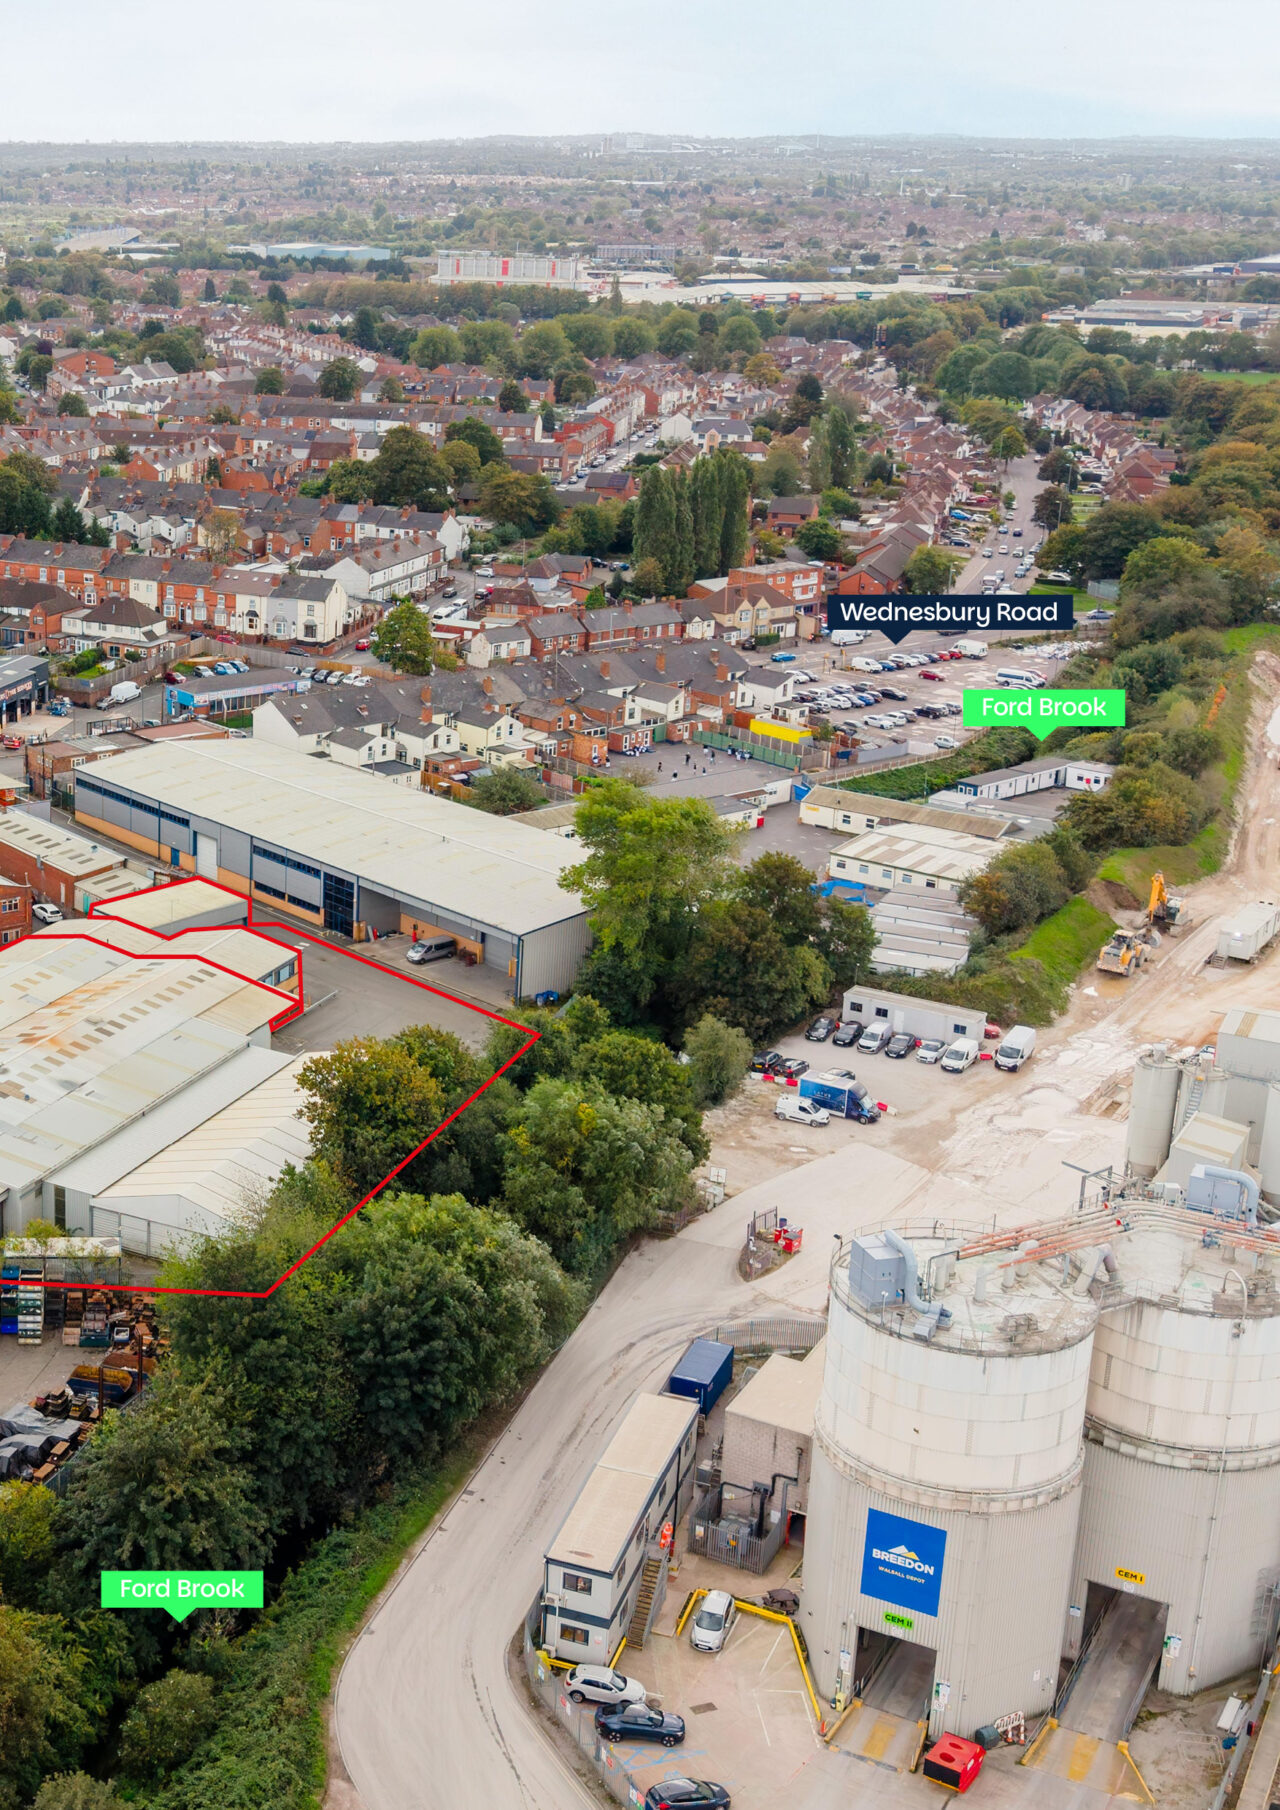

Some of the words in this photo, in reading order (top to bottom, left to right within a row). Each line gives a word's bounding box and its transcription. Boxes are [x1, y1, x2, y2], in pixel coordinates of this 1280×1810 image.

[872, 1548, 935, 1576] BREEDON
[878, 1565, 905, 1578] WALSALL
[905, 1574, 926, 1584] DEPOT
[1118, 1569, 1138, 1581] CEM
[885, 1614, 905, 1625] CEM
